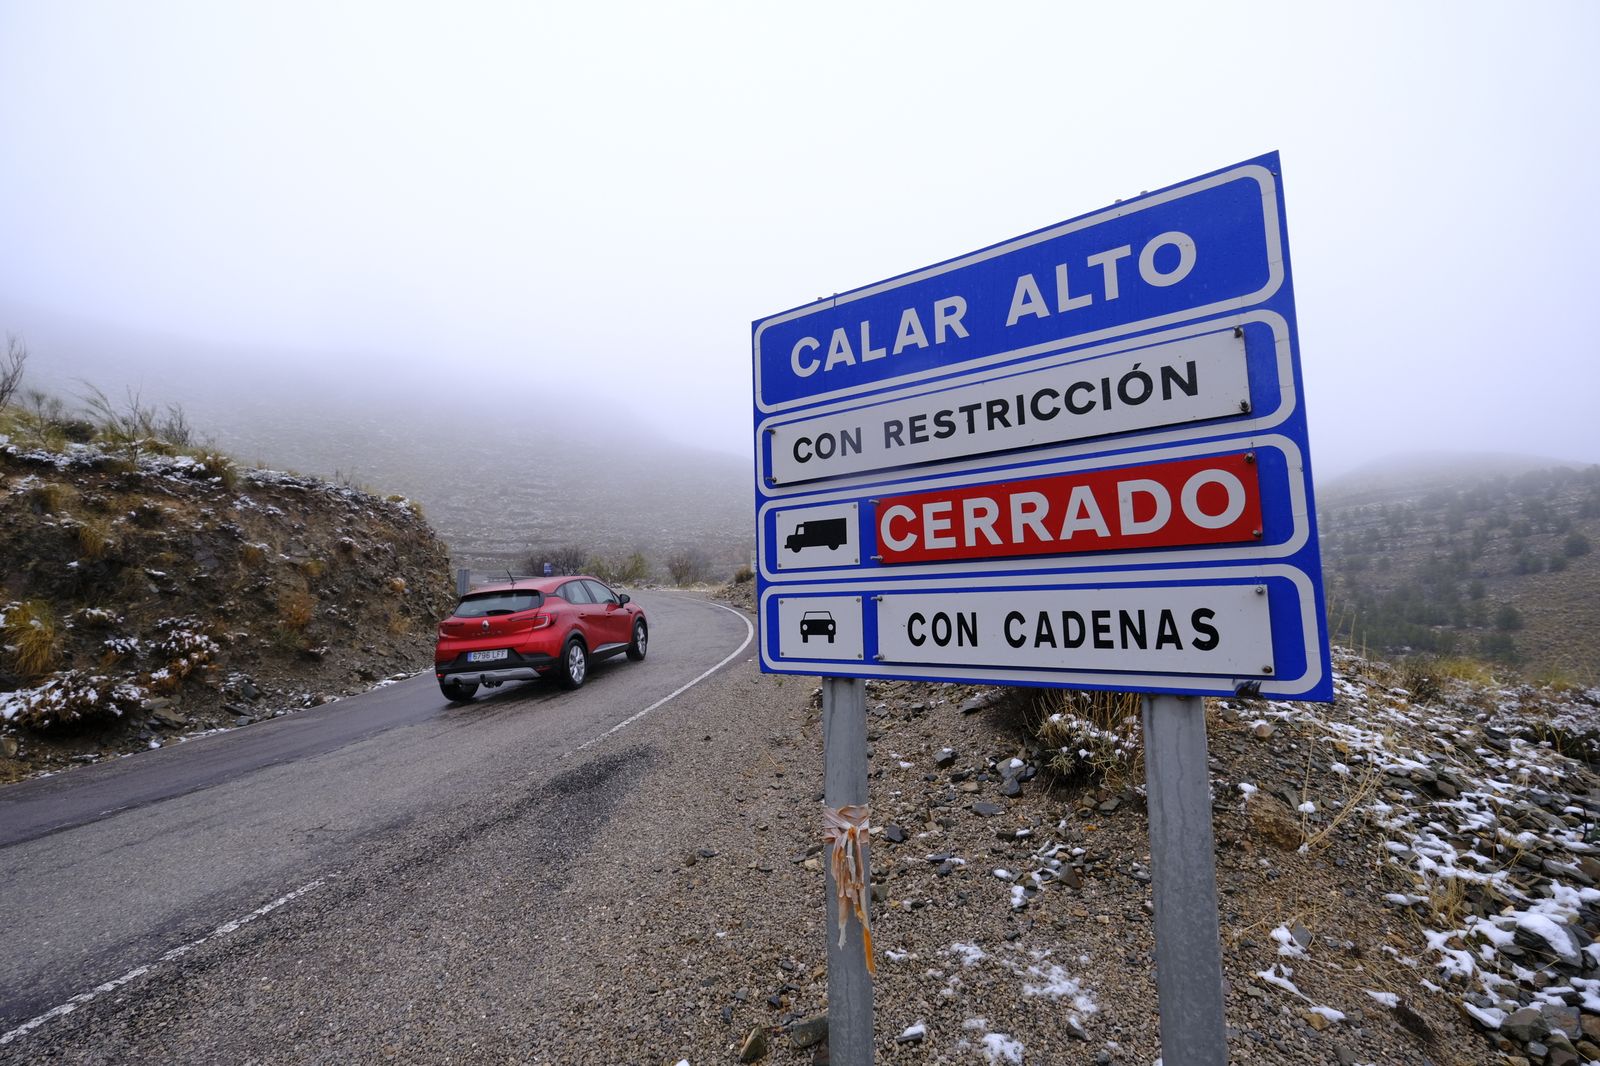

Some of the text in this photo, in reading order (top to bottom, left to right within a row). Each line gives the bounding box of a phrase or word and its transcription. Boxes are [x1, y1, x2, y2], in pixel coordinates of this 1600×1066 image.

[790, 231, 1197, 378] CALAR ALTO
[792, 360, 1199, 464] CON RESTRICCIÓN
[880, 468, 1246, 552] CERRADO
[907, 607, 1220, 652] CON CADENAS
